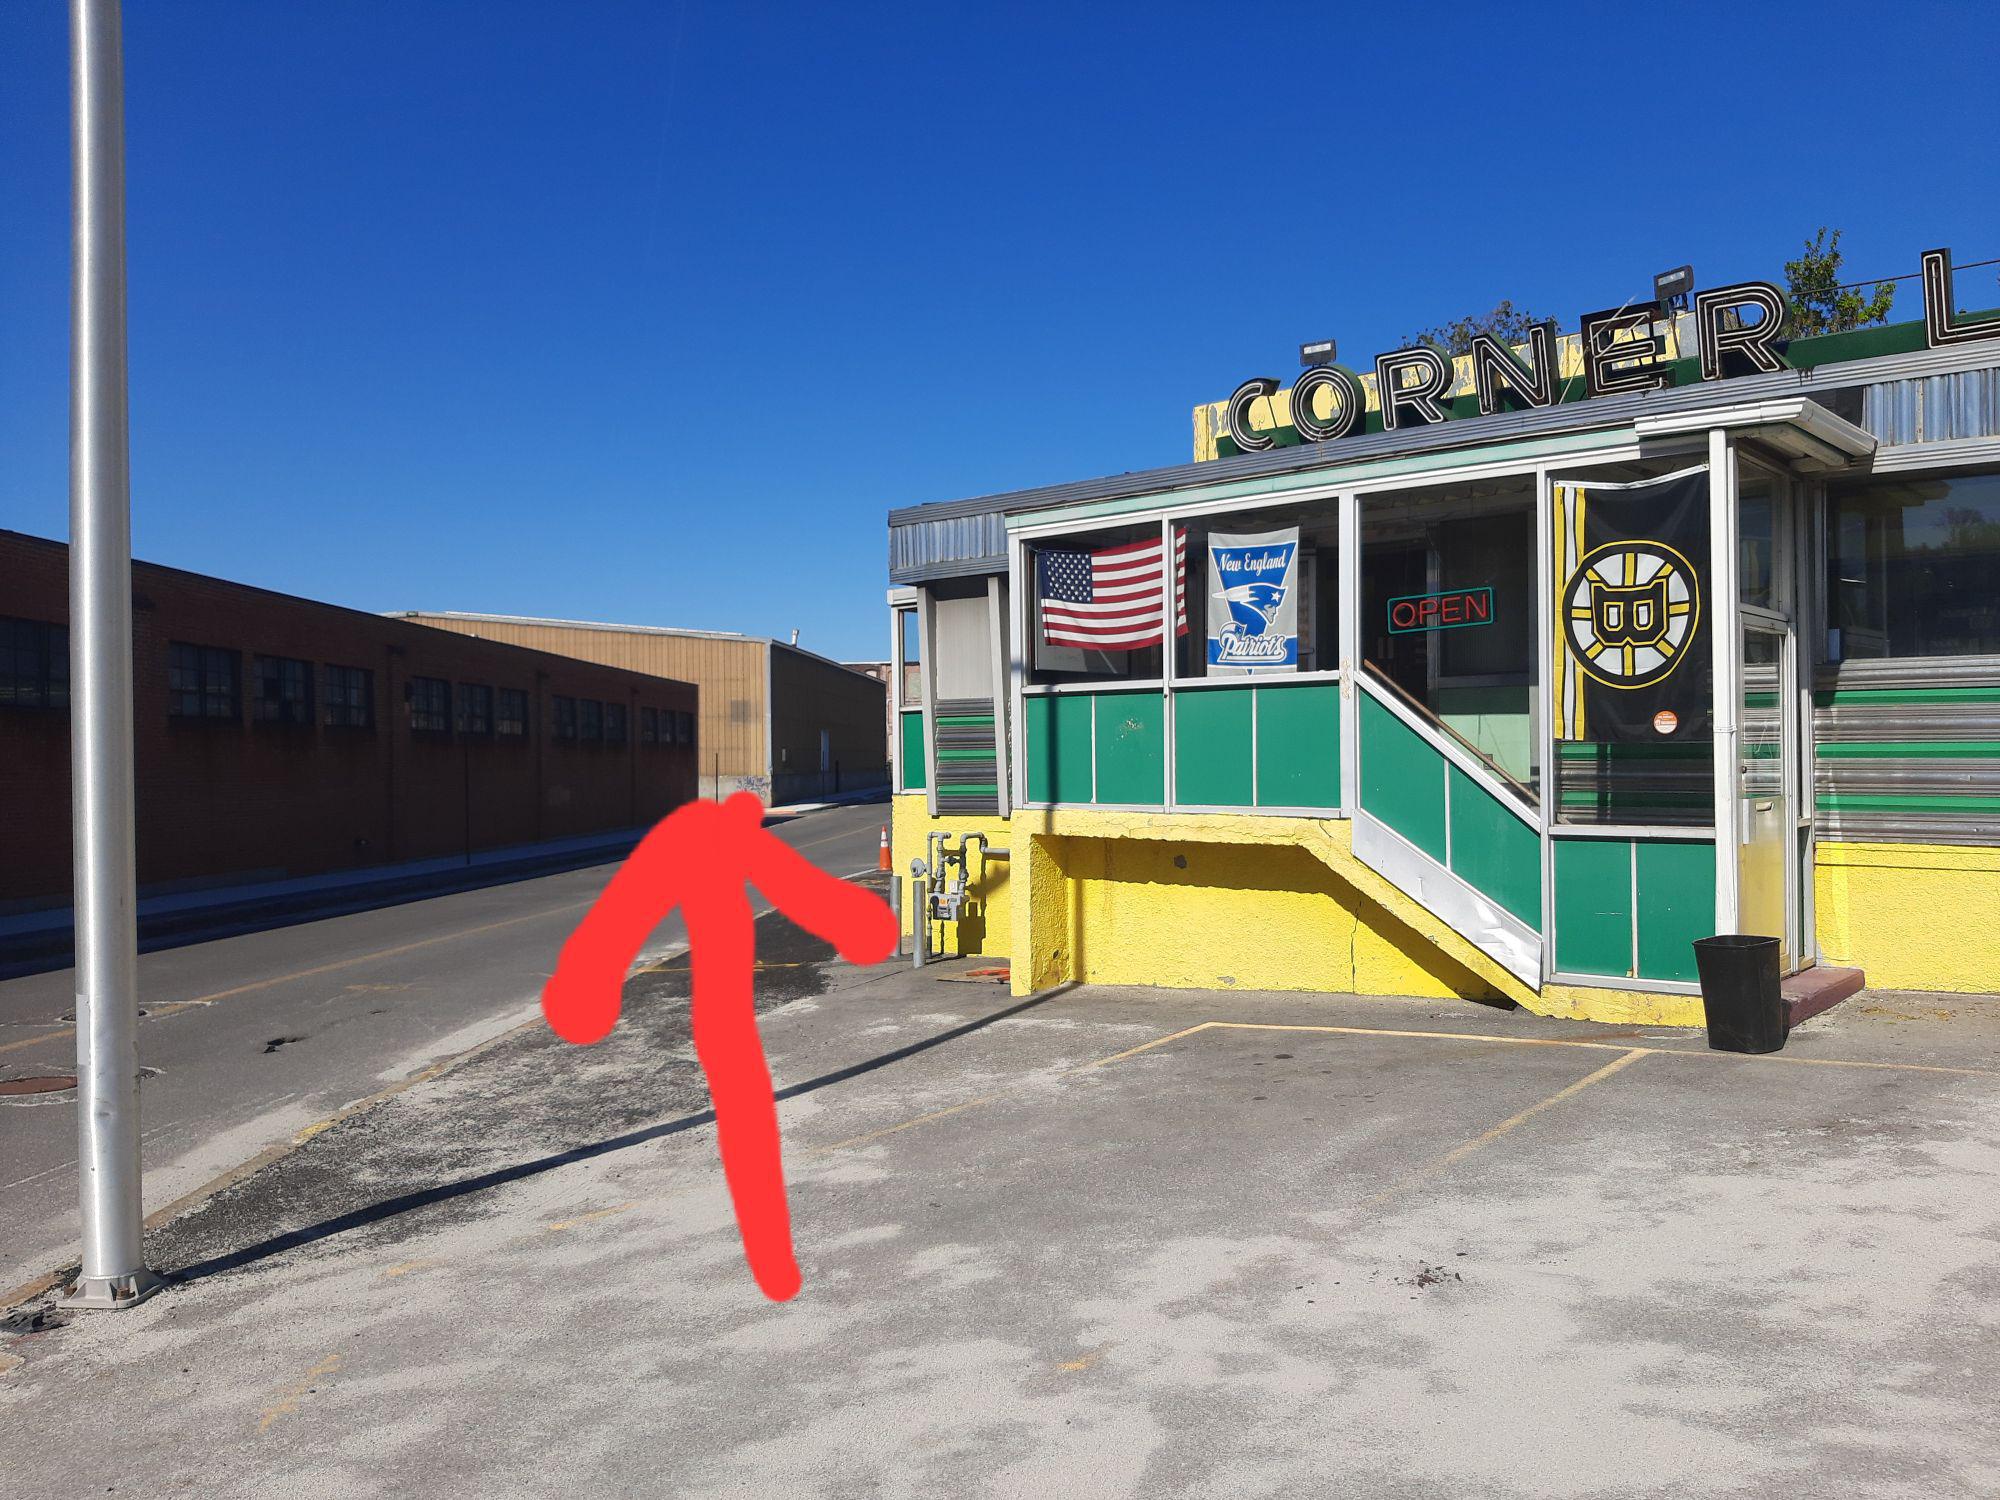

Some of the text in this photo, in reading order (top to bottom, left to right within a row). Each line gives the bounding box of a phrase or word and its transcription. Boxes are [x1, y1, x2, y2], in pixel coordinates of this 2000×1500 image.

[1227, 281, 1792, 452] CORNER
[1219, 550, 1286, 576] New England
[1393, 594, 1487, 627] OPEN
[1219, 632, 1286, 661] Patriots
